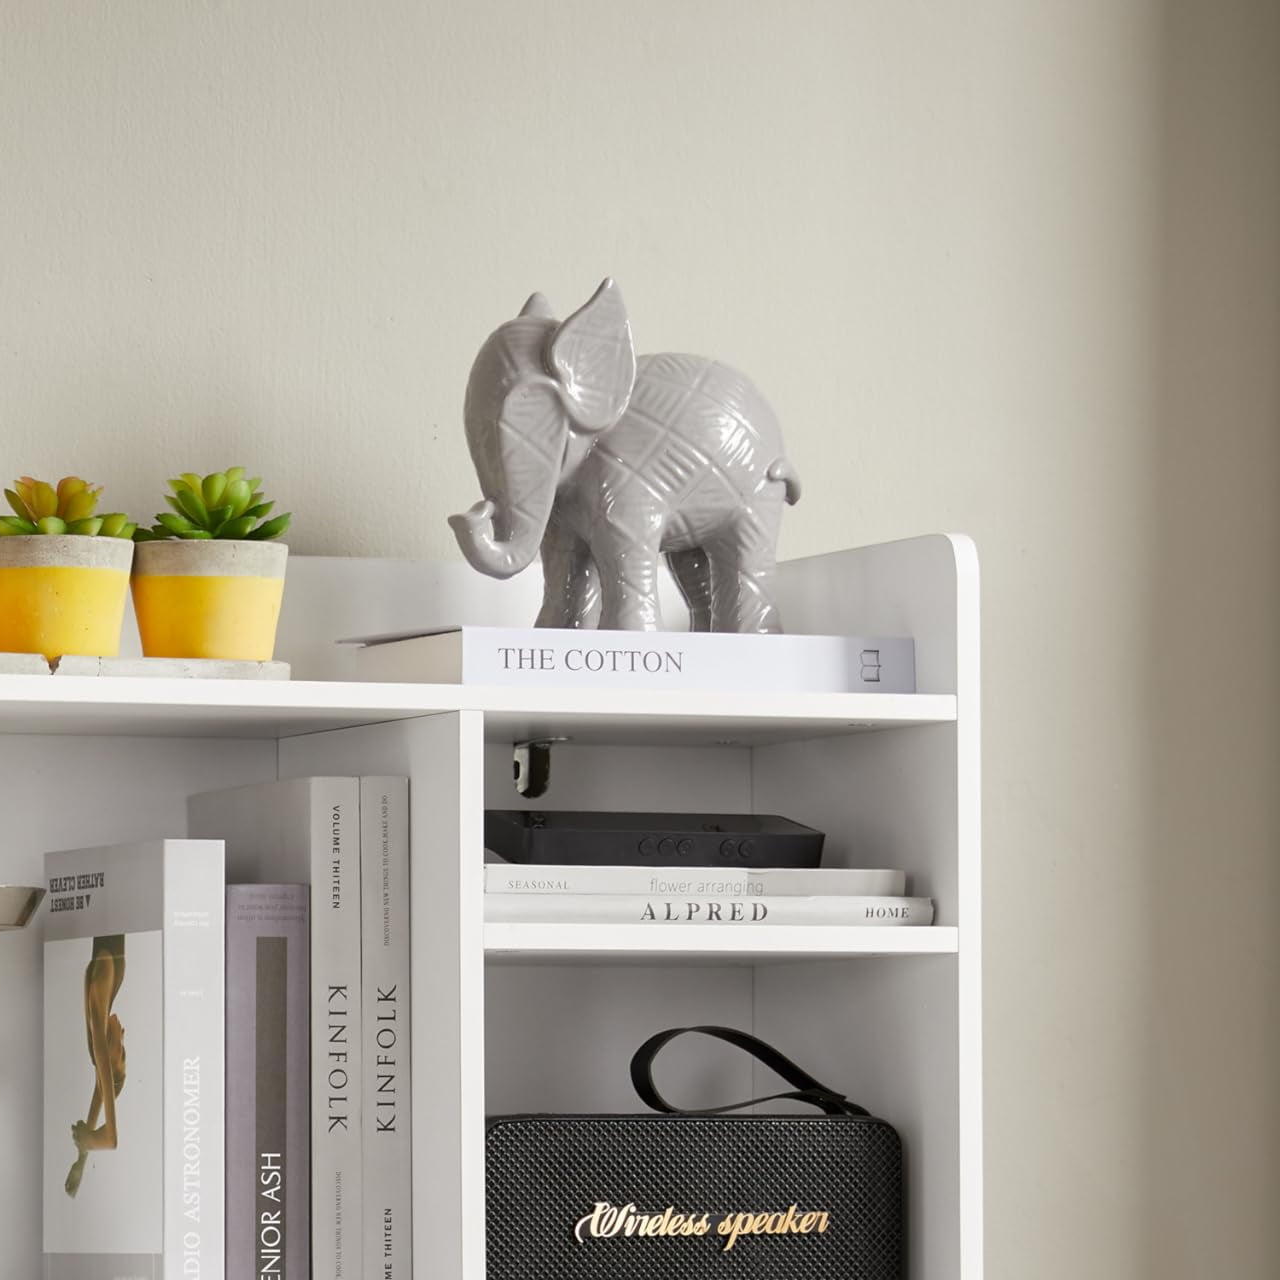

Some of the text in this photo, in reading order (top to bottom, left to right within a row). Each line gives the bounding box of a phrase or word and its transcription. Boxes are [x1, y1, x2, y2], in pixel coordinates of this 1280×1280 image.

[498, 648, 682, 672] THE COTTON
[508, 878, 764, 896] SEASONAL flower arranging
[640, 903, 910, 921] ALPRED HOME
[328, 986, 348, 1132] KINFOLK
[376, 985, 396, 1132] KINFOLK
[183, 1056, 200, 1223] ASTRONOMER
[261, 1153, 281, 1202] ASH
[574, 1201, 830, 1251] Wireless speaker
